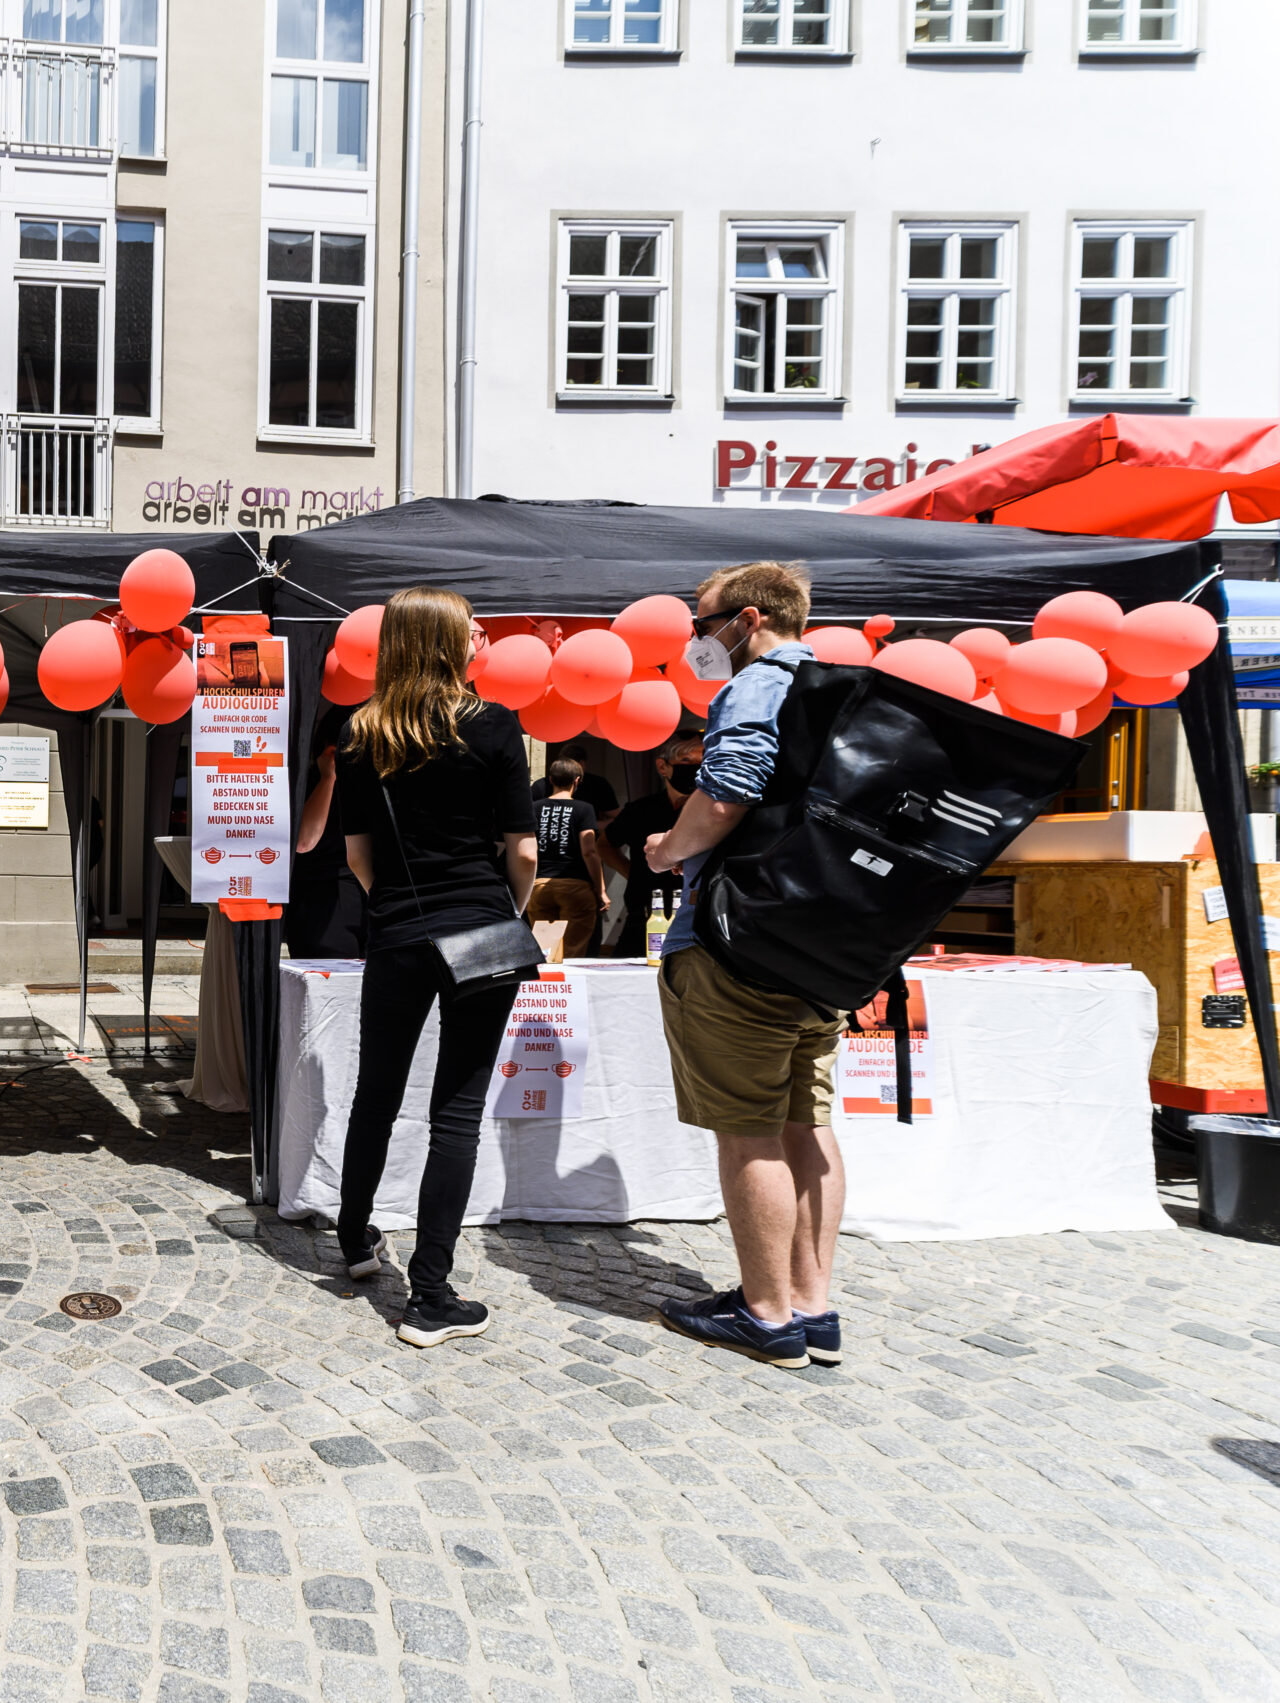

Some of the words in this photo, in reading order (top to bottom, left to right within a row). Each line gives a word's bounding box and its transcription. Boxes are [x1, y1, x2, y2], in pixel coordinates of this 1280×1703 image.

[716, 439, 982, 489] Pizzai
[145, 476, 233, 504] arbeit
[241, 485, 290, 507] am
[301, 486, 384, 511] markt
[202, 697, 279, 711] AUDIOGUIDE
[213, 715, 240, 723] EINFACH
[241, 715, 250, 723] QR
[251, 715, 268, 723] CODE
[200, 725, 230, 733] SCANNEN
[246, 726, 280, 734] LOSZIEHEN
[206, 774, 228, 783] BITTE
[231, 774, 260, 783] HALTEN
[262, 774, 274, 784] SIE
[212, 788, 249, 797] ABSTAND
[251, 788, 269, 797] UND
[213, 802, 254, 811] BEDECKEN
[256, 802, 268, 811] SIE
[207, 815, 232, 824] MUND
[234, 815, 252, 824] UND
[253, 815, 274, 824] NASE
[549, 805, 562, 842] CREATE
[538, 805, 551, 852] CONNECT
[225, 829, 256, 838] DANKE!
[528, 984, 558, 993] HALTEN
[560, 984, 572, 994] SIE
[550, 999, 567, 1008] UND
[512, 1014, 553, 1023] BEDECKEN
[555, 1014, 567, 1023] SIE
[507, 1028, 532, 1037] MUND
[534, 1028, 551, 1037] UND
[553, 1028, 573, 1037] NASE
[524, 1043, 555, 1052] DANKE!
[847, 1040, 924, 1053] AUDIOGDE
[858, 1058, 885, 1066] EINFACH
[845, 1069, 875, 1077] SCANNEN
[877, 1070, 891, 1078] UND
